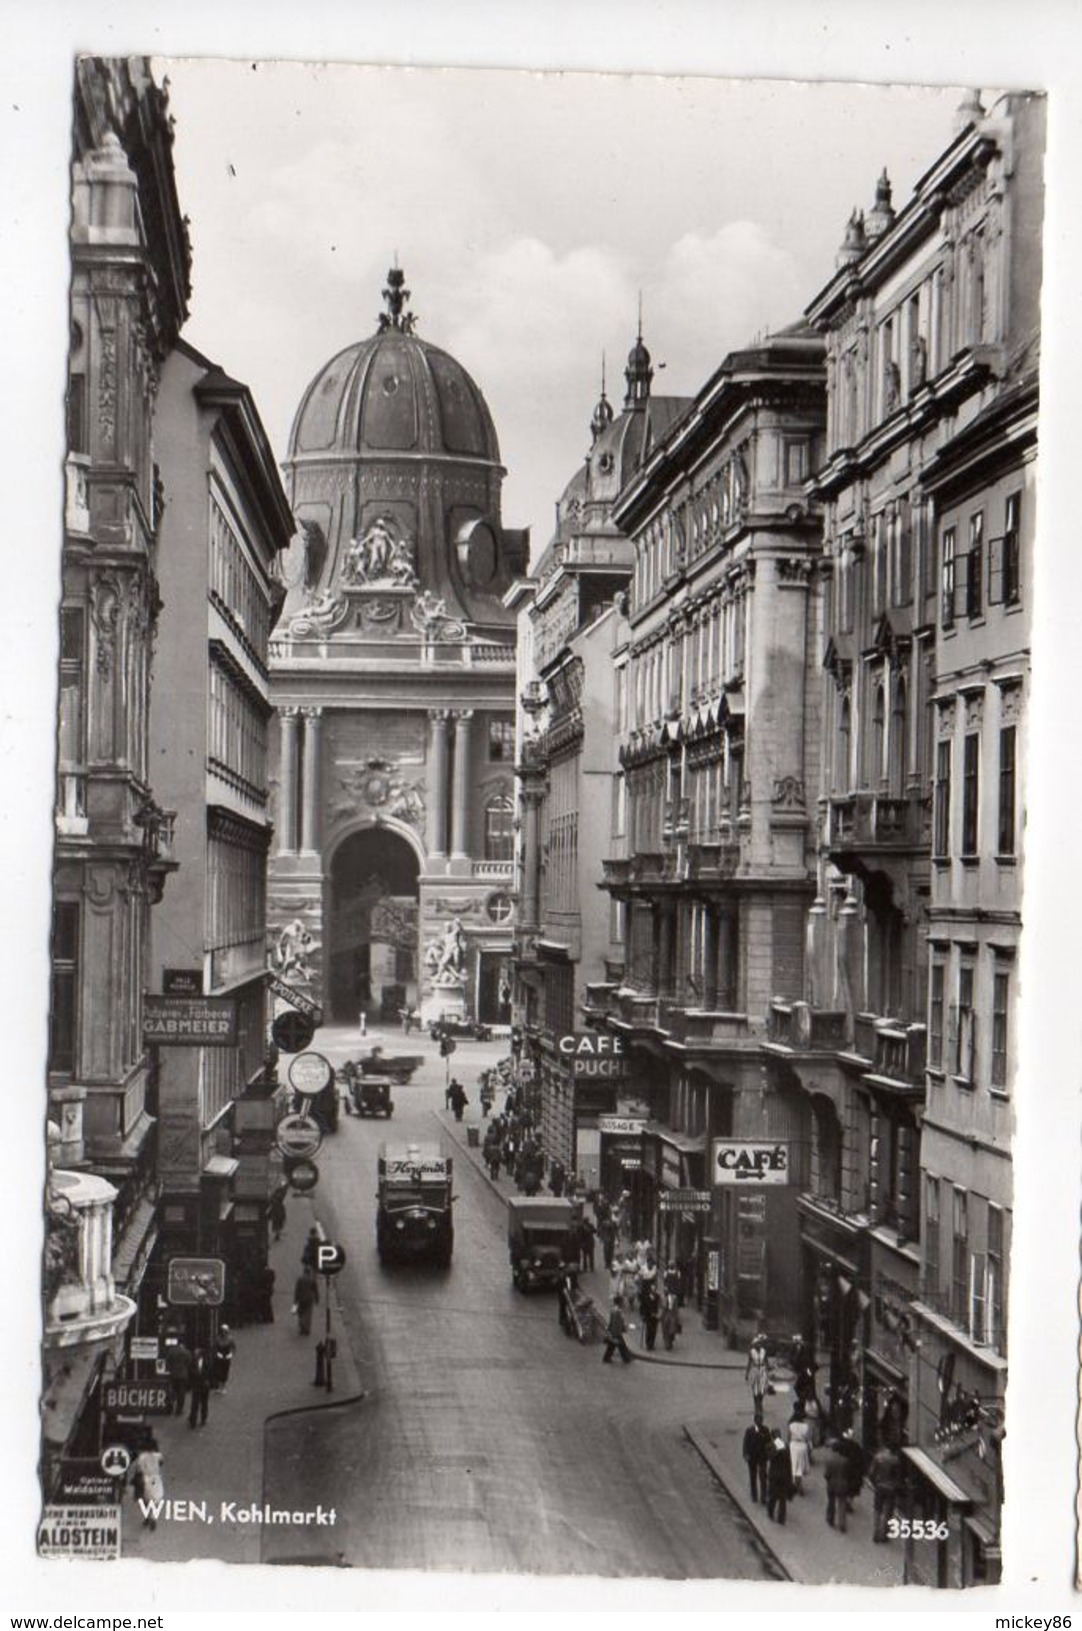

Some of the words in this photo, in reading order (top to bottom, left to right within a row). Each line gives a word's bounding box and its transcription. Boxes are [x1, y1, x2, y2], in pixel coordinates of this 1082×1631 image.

[270, 980, 314, 1014] APOTHEKE
[144, 1020, 229, 1033] GABMEIER
[717, 1146, 787, 1171] CAFÉ
[318, 1246, 338, 1269] P
[108, 1385, 167, 1407] BÜCHER
